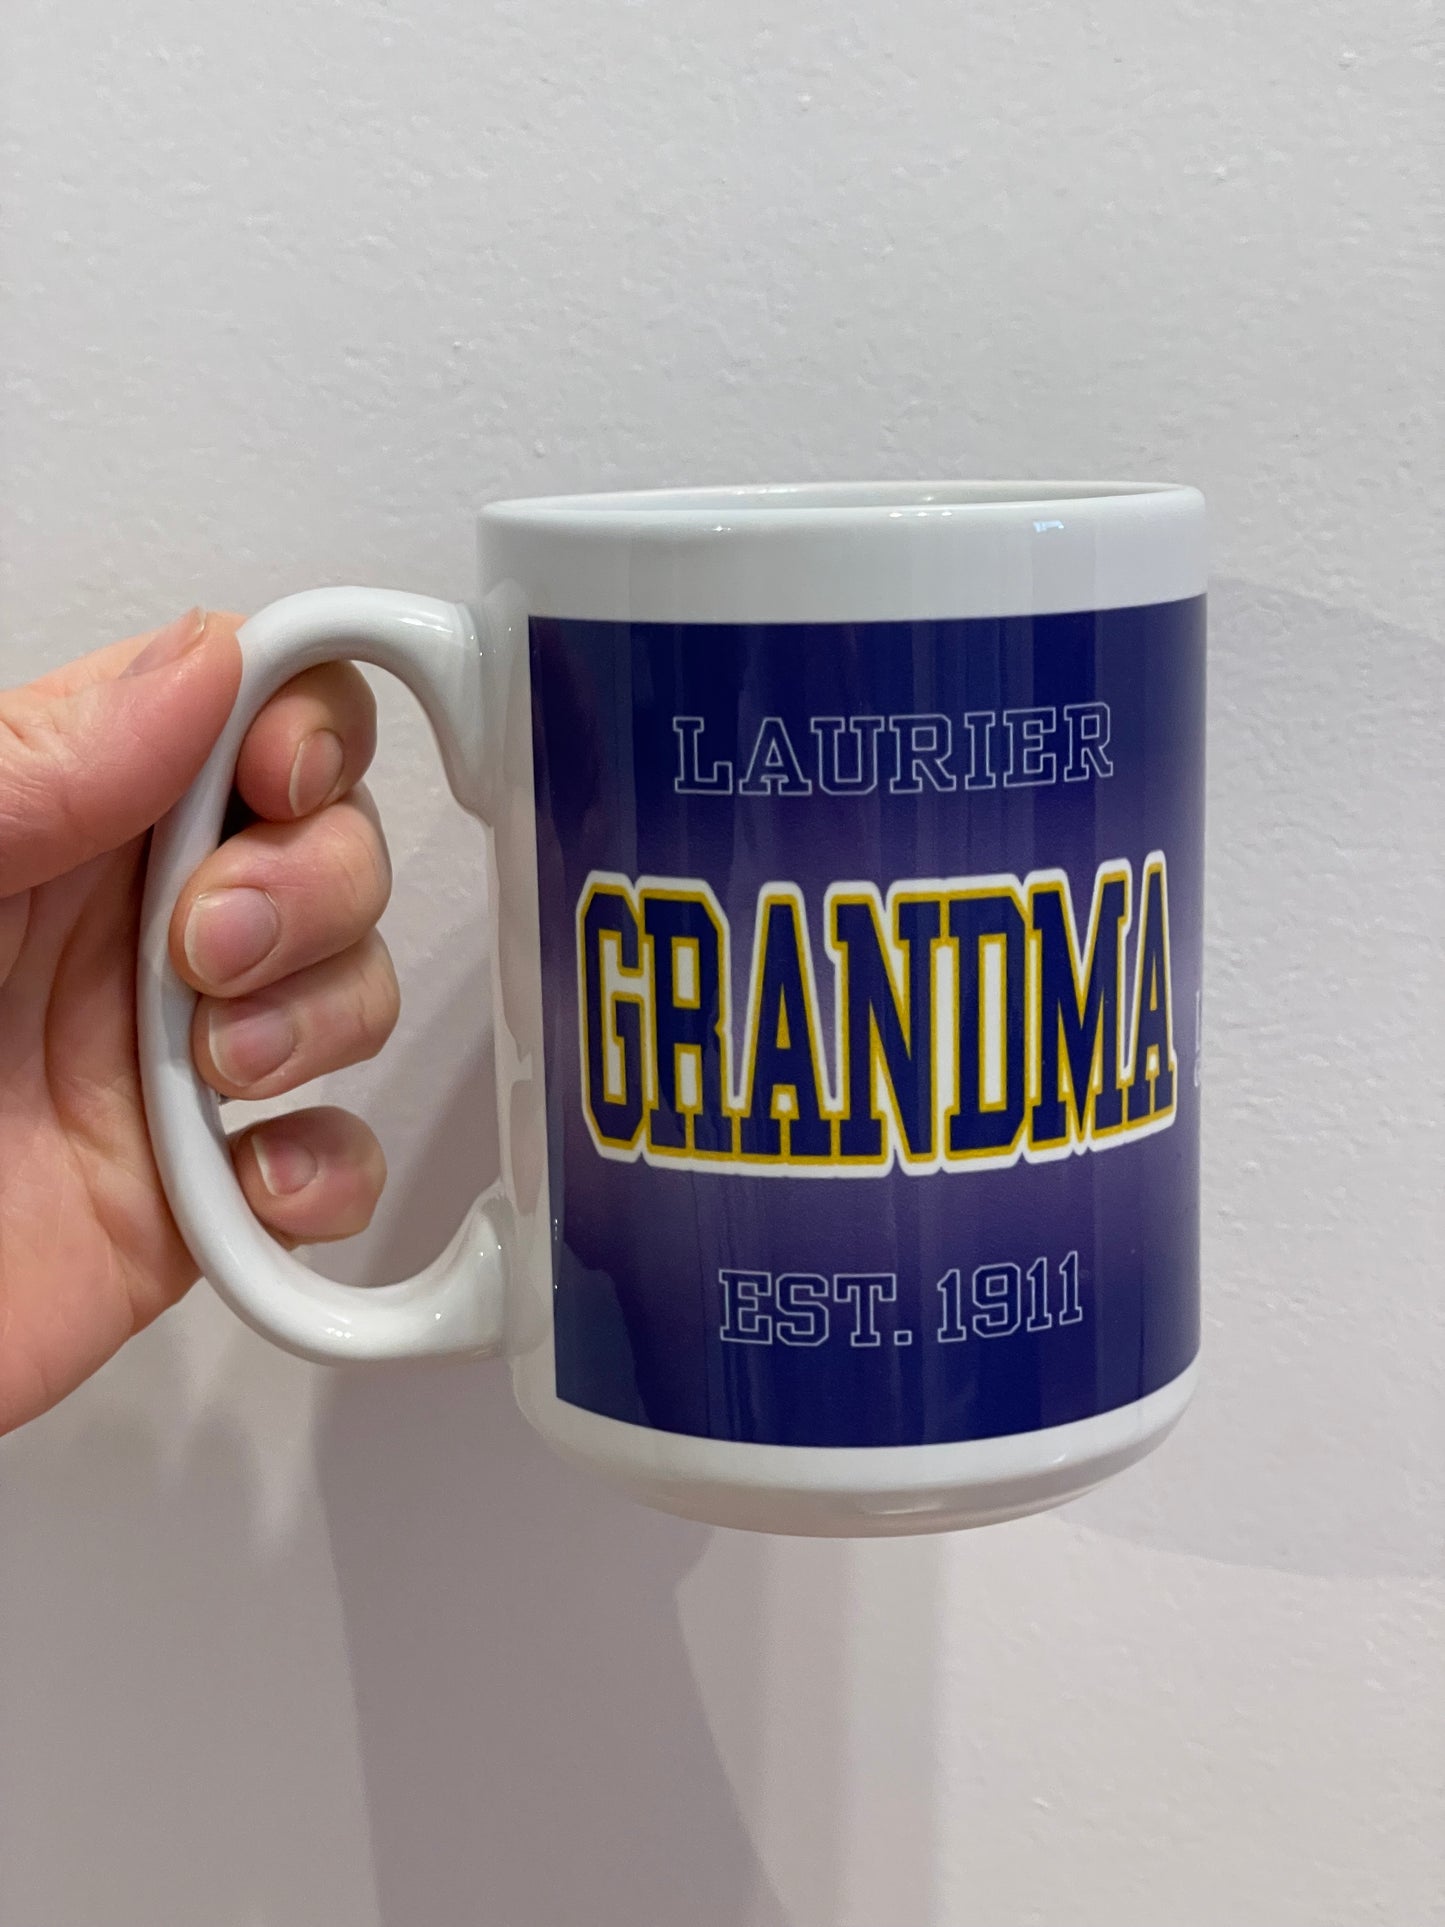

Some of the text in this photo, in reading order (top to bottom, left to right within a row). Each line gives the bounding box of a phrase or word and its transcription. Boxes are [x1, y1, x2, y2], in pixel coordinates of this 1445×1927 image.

[672, 701, 1114, 796] LAURIER
[577, 849, 1176, 1178] GRANDMA
[718, 1251, 1083, 1347] EST. 1911
